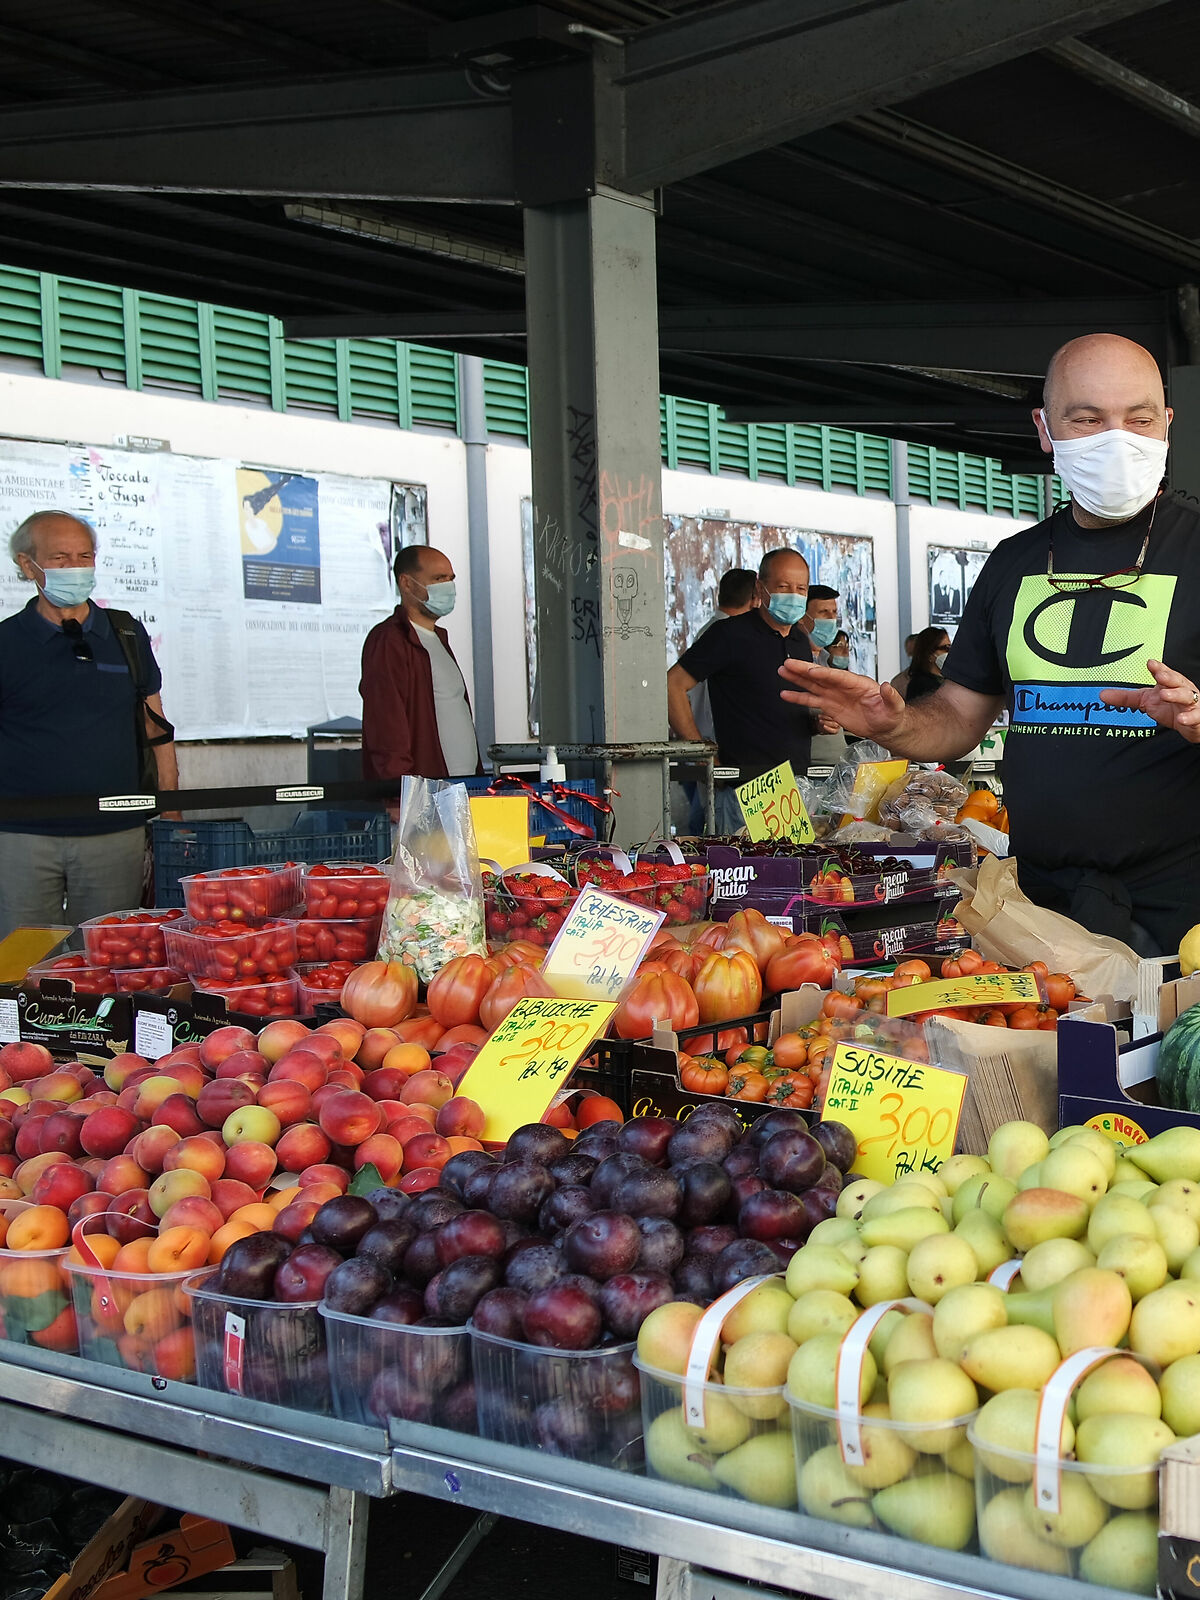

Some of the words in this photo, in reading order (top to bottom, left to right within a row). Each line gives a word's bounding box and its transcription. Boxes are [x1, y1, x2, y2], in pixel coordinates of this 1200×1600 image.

[4, 475, 64, 489] AMBIENTALE
[96, 464, 150, 485] Toccata
[108, 484, 146, 508] Fuga
[1050, 726, 1101, 737] ATHLETIC
[762, 788, 801, 837] 5,00
[710, 864, 755, 882] mean
[883, 871, 910, 888] mean
[711, 880, 750, 904] frutta
[880, 927, 908, 943] mean
[882, 940, 906, 960] frutta
[25, 1003, 66, 1025] Cuore
[67, 1005, 105, 1029] Verde
[498, 1019, 537, 1033] ITALIA
[88, 1033, 105, 1042] ZARA
[836, 1051, 925, 1091] SUSINE
[830, 1071, 875, 1097] ITALIA
[857, 1092, 953, 1159] 3,00
